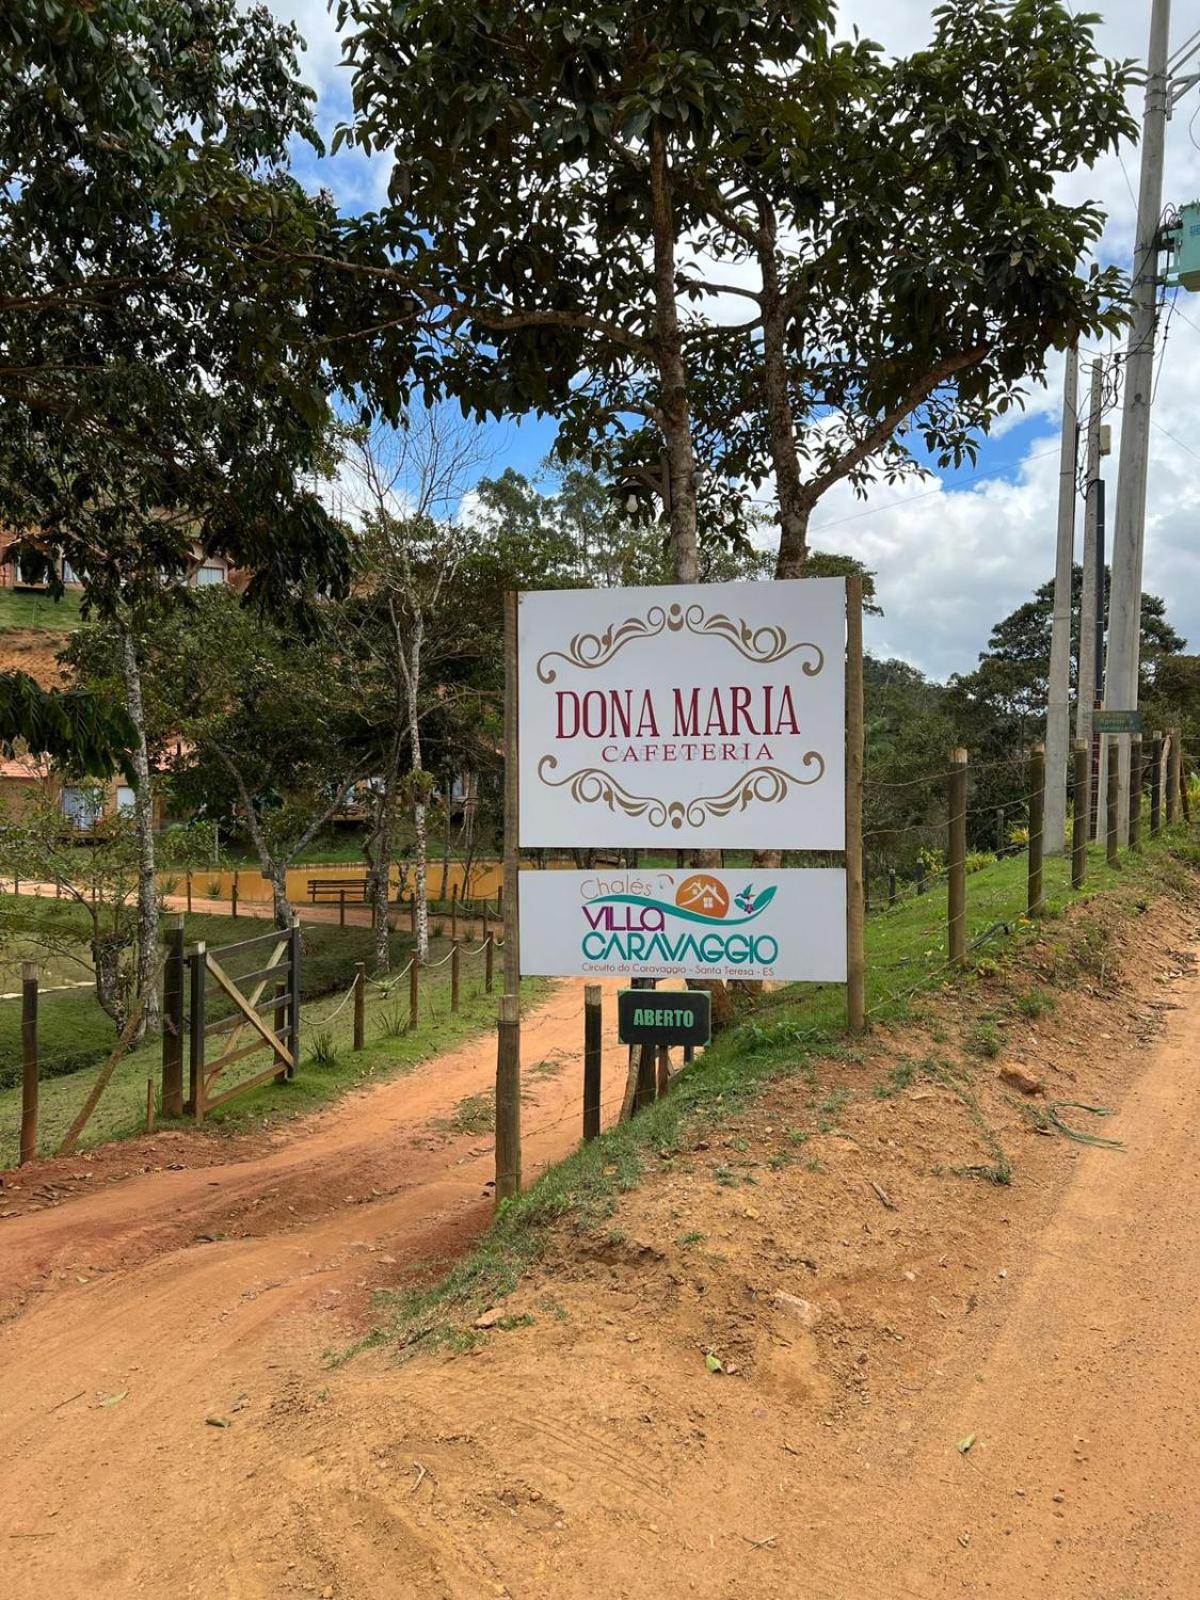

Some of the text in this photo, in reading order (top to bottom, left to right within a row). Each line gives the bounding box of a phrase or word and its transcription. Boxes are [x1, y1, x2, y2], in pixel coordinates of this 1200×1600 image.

[555, 685, 800, 738] DONA MARIA
[601, 743, 774, 763] CAFETERIA
[580, 872, 653, 899] Chalés
[581, 931, 779, 965] CARAVAGGIO
[582, 962, 615, 972] Circuito
[632, 963, 687, 974] Caravaggio
[695, 965, 722, 975] Santa
[724, 966, 754, 976] Teresa
[762, 967, 775, 976] ES
[633, 1008, 694, 1028] ABERTO
